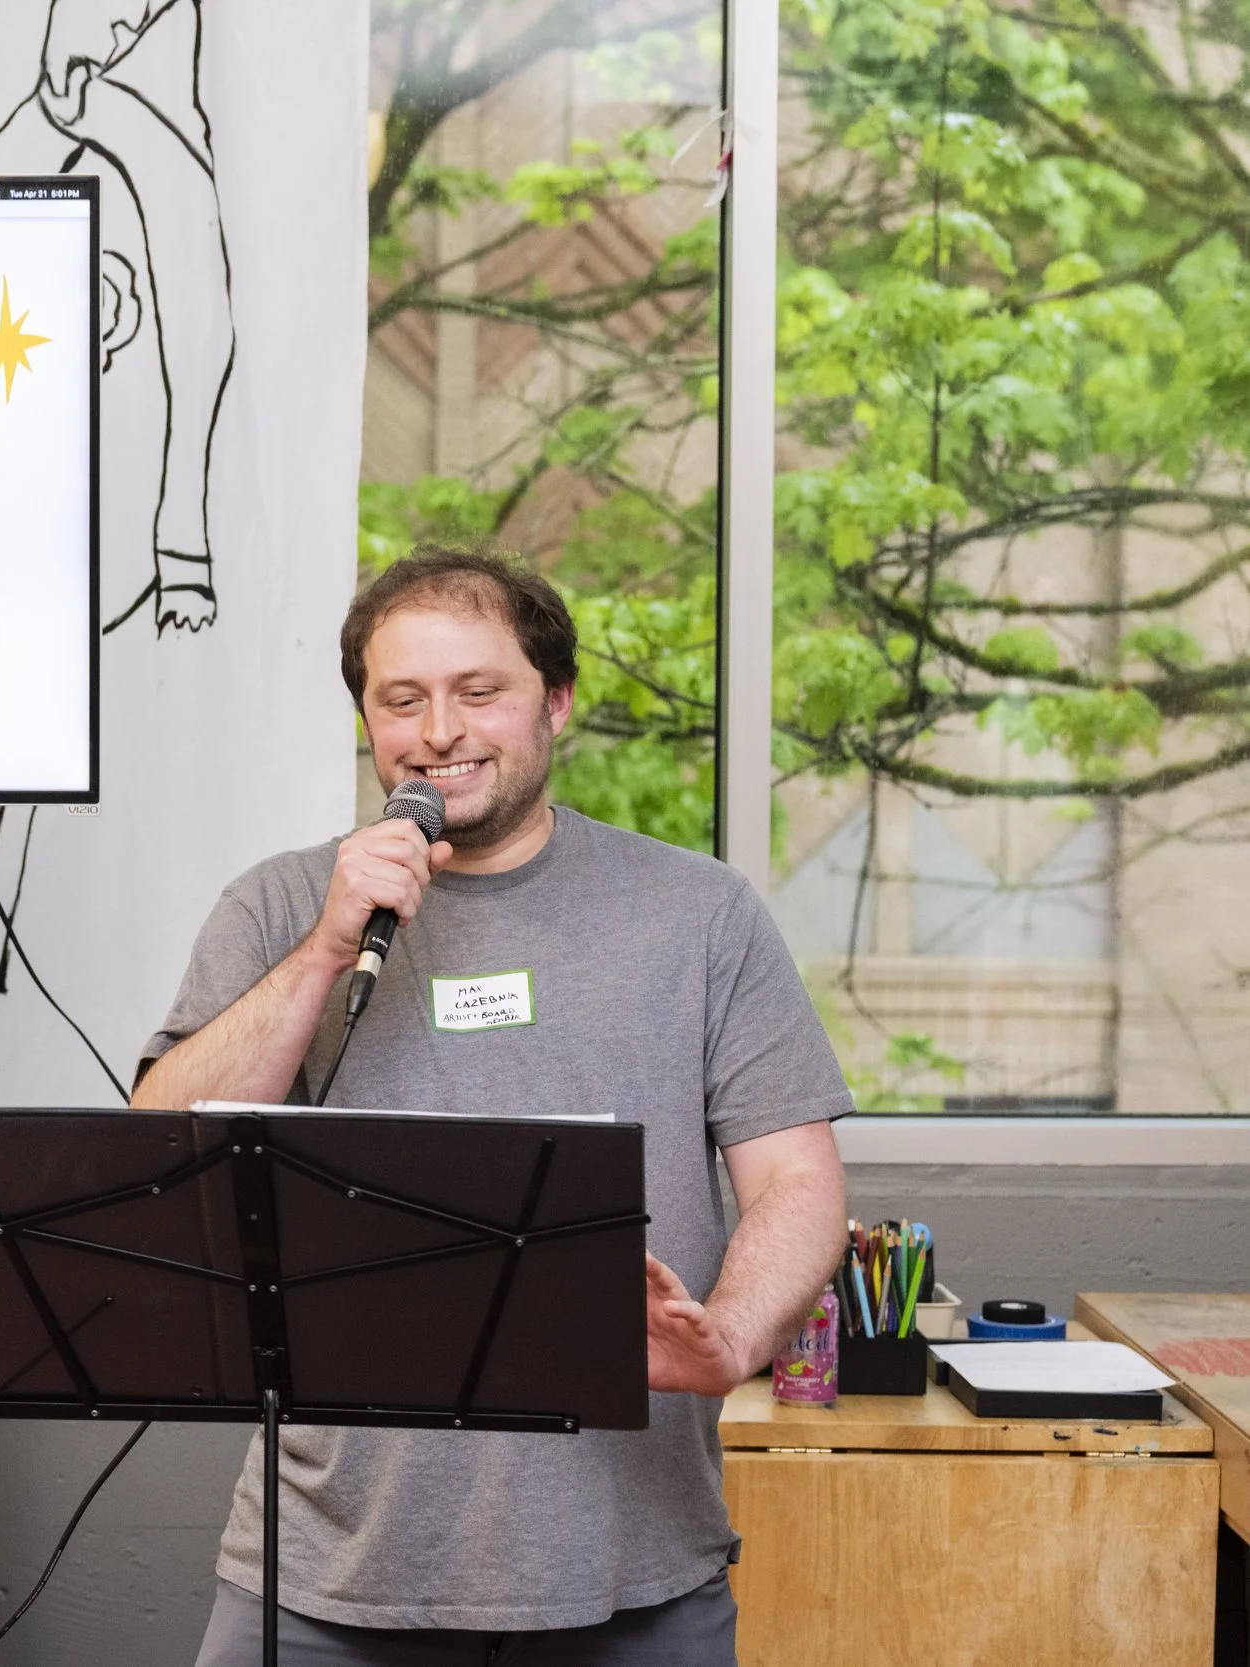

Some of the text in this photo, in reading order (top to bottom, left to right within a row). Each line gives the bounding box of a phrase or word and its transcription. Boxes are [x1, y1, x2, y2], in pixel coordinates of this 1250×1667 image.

[10, 189, 23, 198] Tue
[24, 189, 37, 199] Apr
[68, 805, 99, 814] VIZIO
[458, 986, 482, 997] MAX
[455, 992, 519, 1009] LAZEBNIK
[481, 1007, 516, 1019] BOARD
